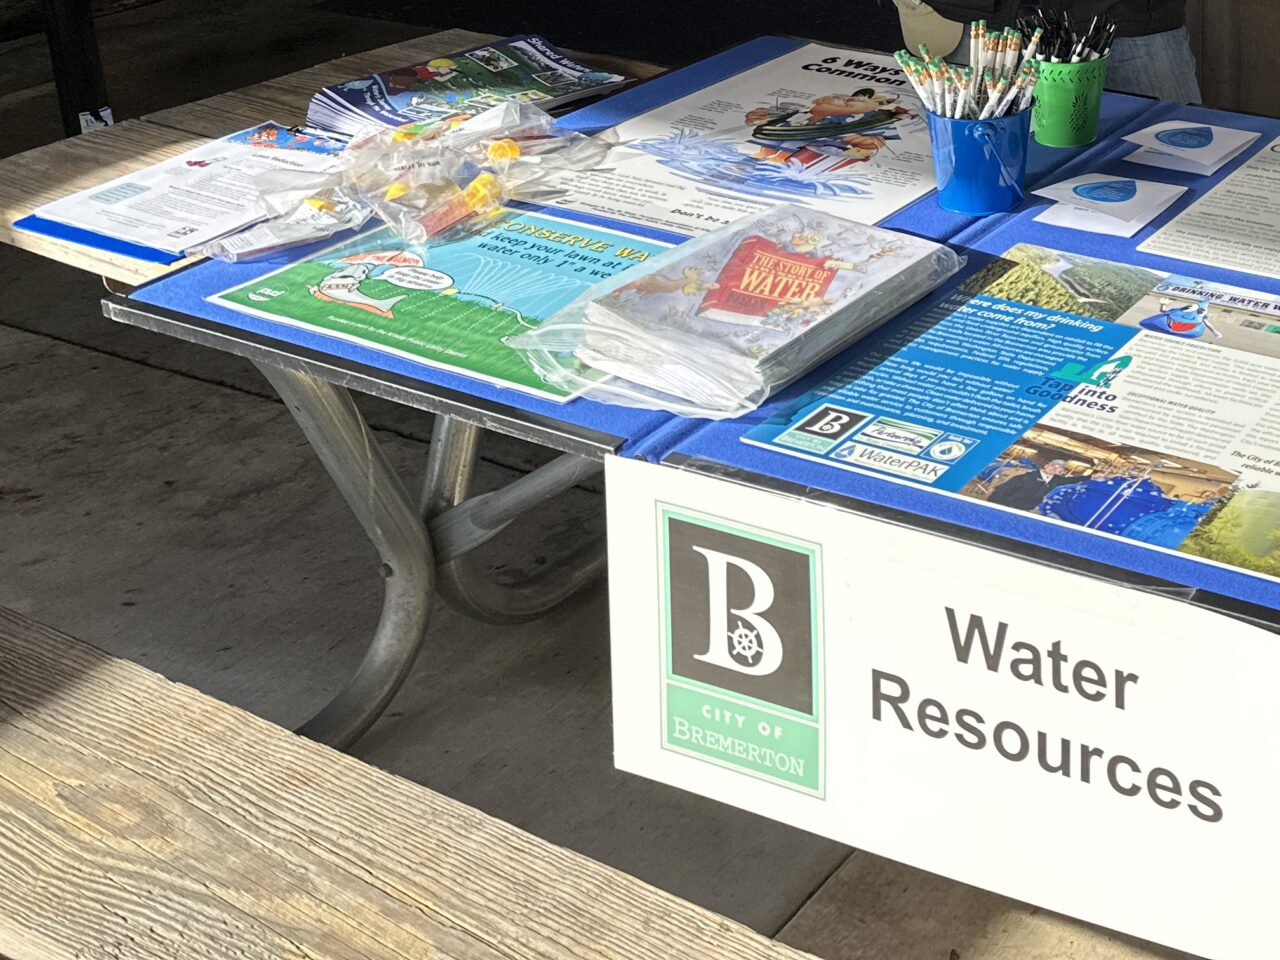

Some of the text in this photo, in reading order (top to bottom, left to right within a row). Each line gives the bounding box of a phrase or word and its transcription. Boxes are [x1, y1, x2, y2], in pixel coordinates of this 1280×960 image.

[528, 37, 561, 59] Shared
[801, 63, 905, 86] Common
[822, 57, 903, 76] 6 Ways
[478, 243, 518, 256] water
[521, 251, 554, 264] only
[492, 233, 619, 269] keep your lawn at
[752, 252, 777, 268] THE
[777, 261, 813, 276] STORY
[814, 269, 830, 280] OF
[740, 267, 820, 301] WATER
[1171, 286, 1223, 300] DRINKING
[1229, 296, 1270, 309] WATER
[977, 309, 1011, 322] come
[1014, 317, 1055, 330] from?
[992, 303, 1022, 315] does
[1025, 310, 1048, 320] my
[1048, 314, 1104, 332] drinking
[1024, 385, 1118, 414] Goodness
[1040, 377, 1117, 402] Tap into
[805, 411, 850, 435] B
[859, 448, 945, 477] WaterPAK
[1232, 450, 1246, 458] The
[1247, 454, 1263, 463] City
[1241, 462, 1273, 474] reliable
[692, 544, 784, 677] B
[944, 605, 1139, 711] Water
[701, 703, 784, 740] CITY OF
[672, 716, 805, 777] BREMERTON
[870, 667, 1225, 824] Resources
